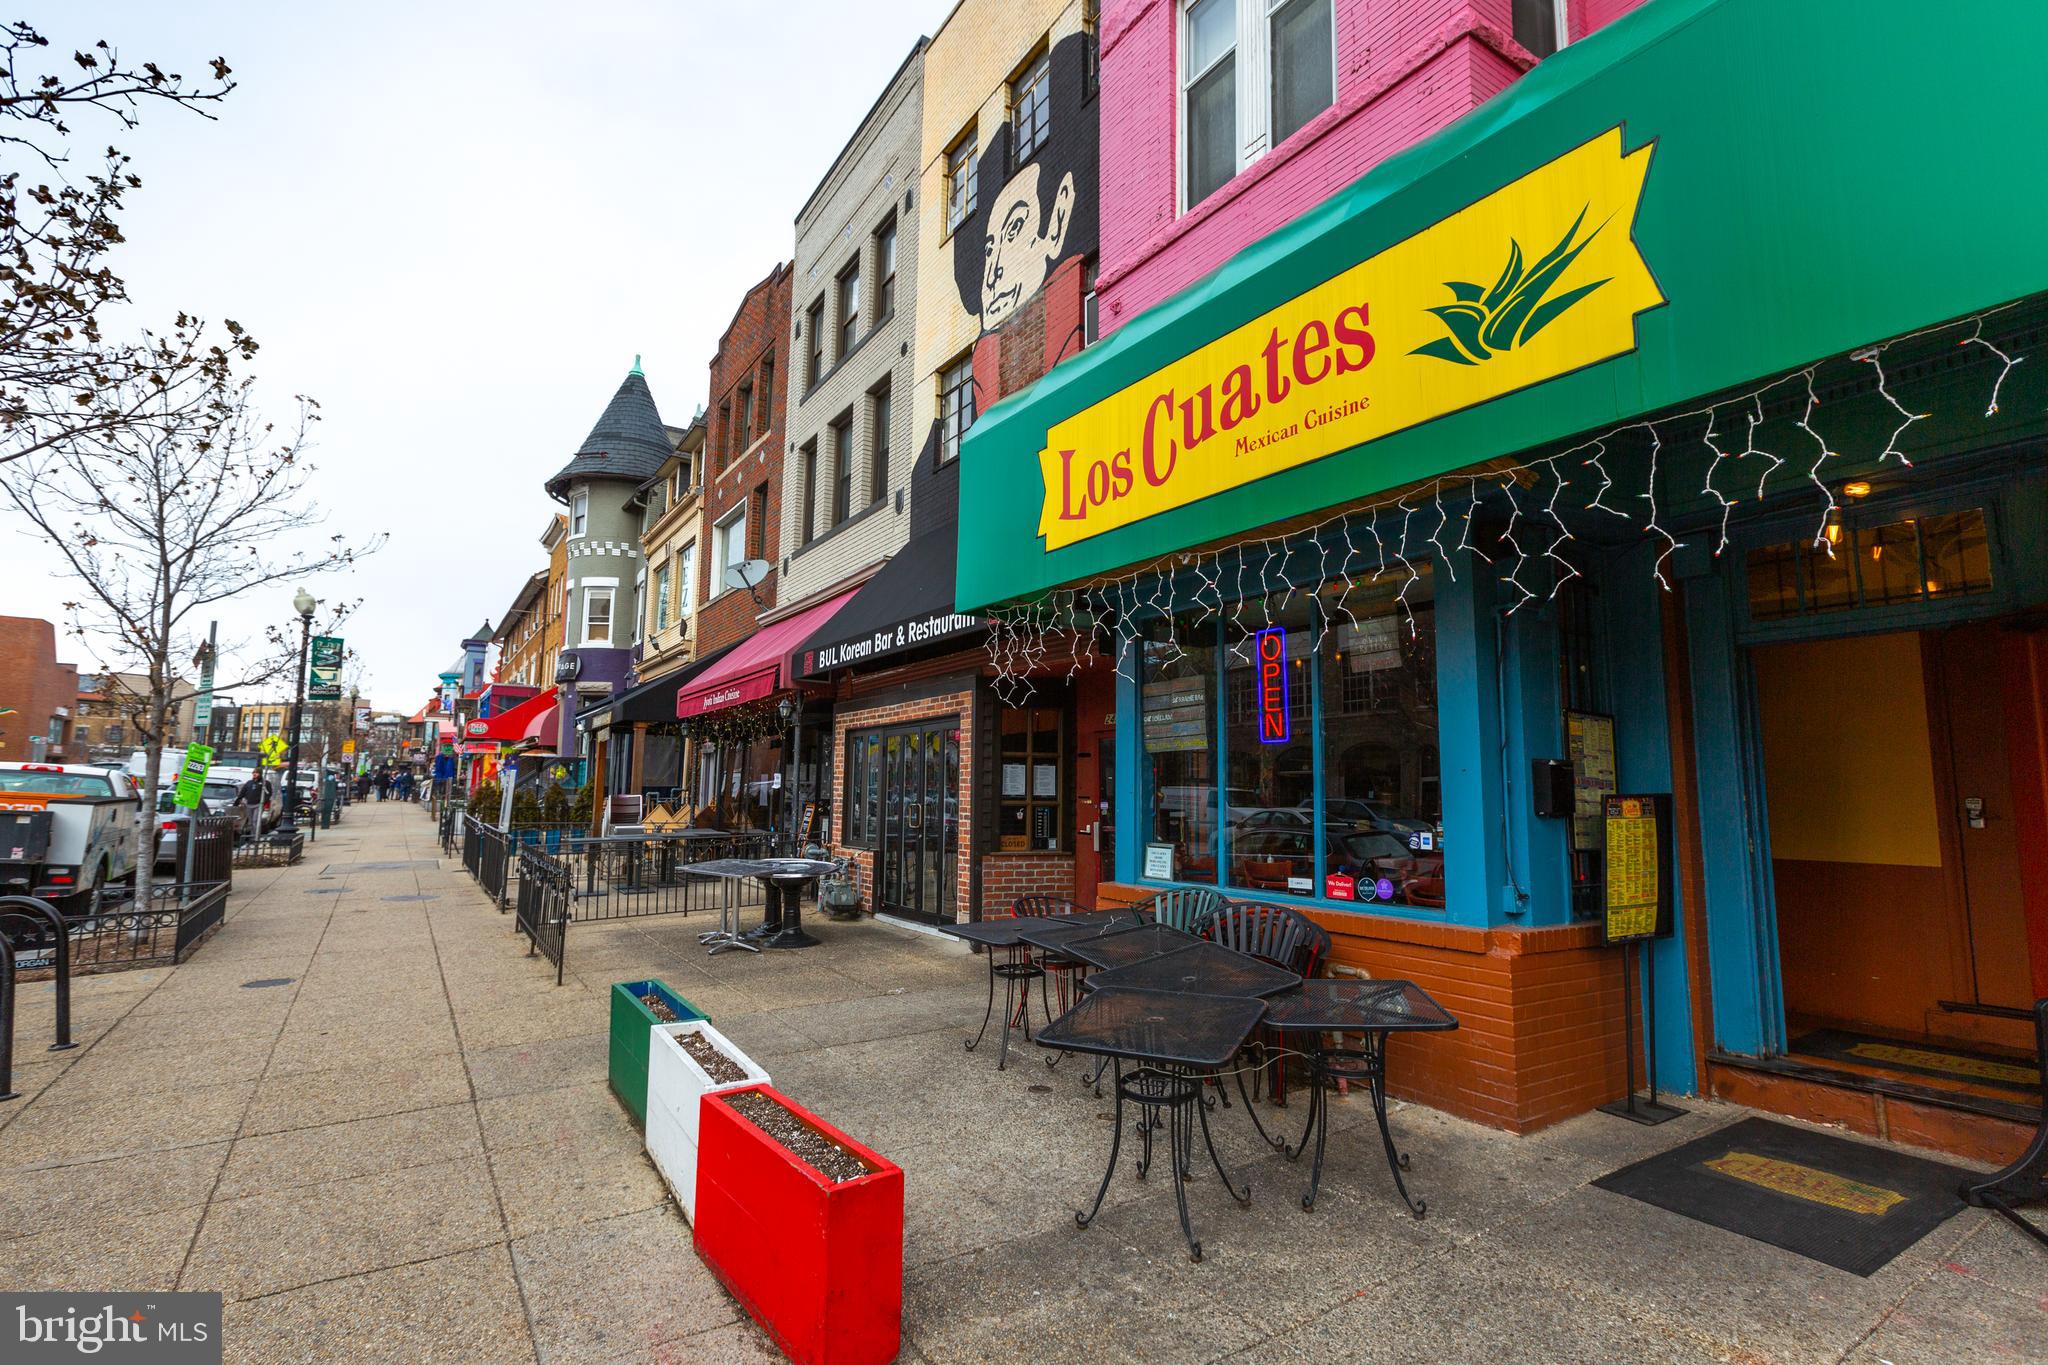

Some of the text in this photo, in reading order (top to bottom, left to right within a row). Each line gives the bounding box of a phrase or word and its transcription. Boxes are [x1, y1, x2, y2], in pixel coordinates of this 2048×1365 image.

[1058, 302, 1376, 521] Los Cuates
[1234, 396, 1370, 457] Mexican Cuisine
[818, 648, 838, 668] BUL
[839, 639, 872, 663] Korean
[874, 632, 893, 652] Bar
[896, 625, 905, 647] &
[725, 687, 741, 701] Cuisine
[1261, 634, 1283, 737] OPEN
[1001, 840, 1026, 848] CLOSED
[15, 959, 49, 968] ORGAN
